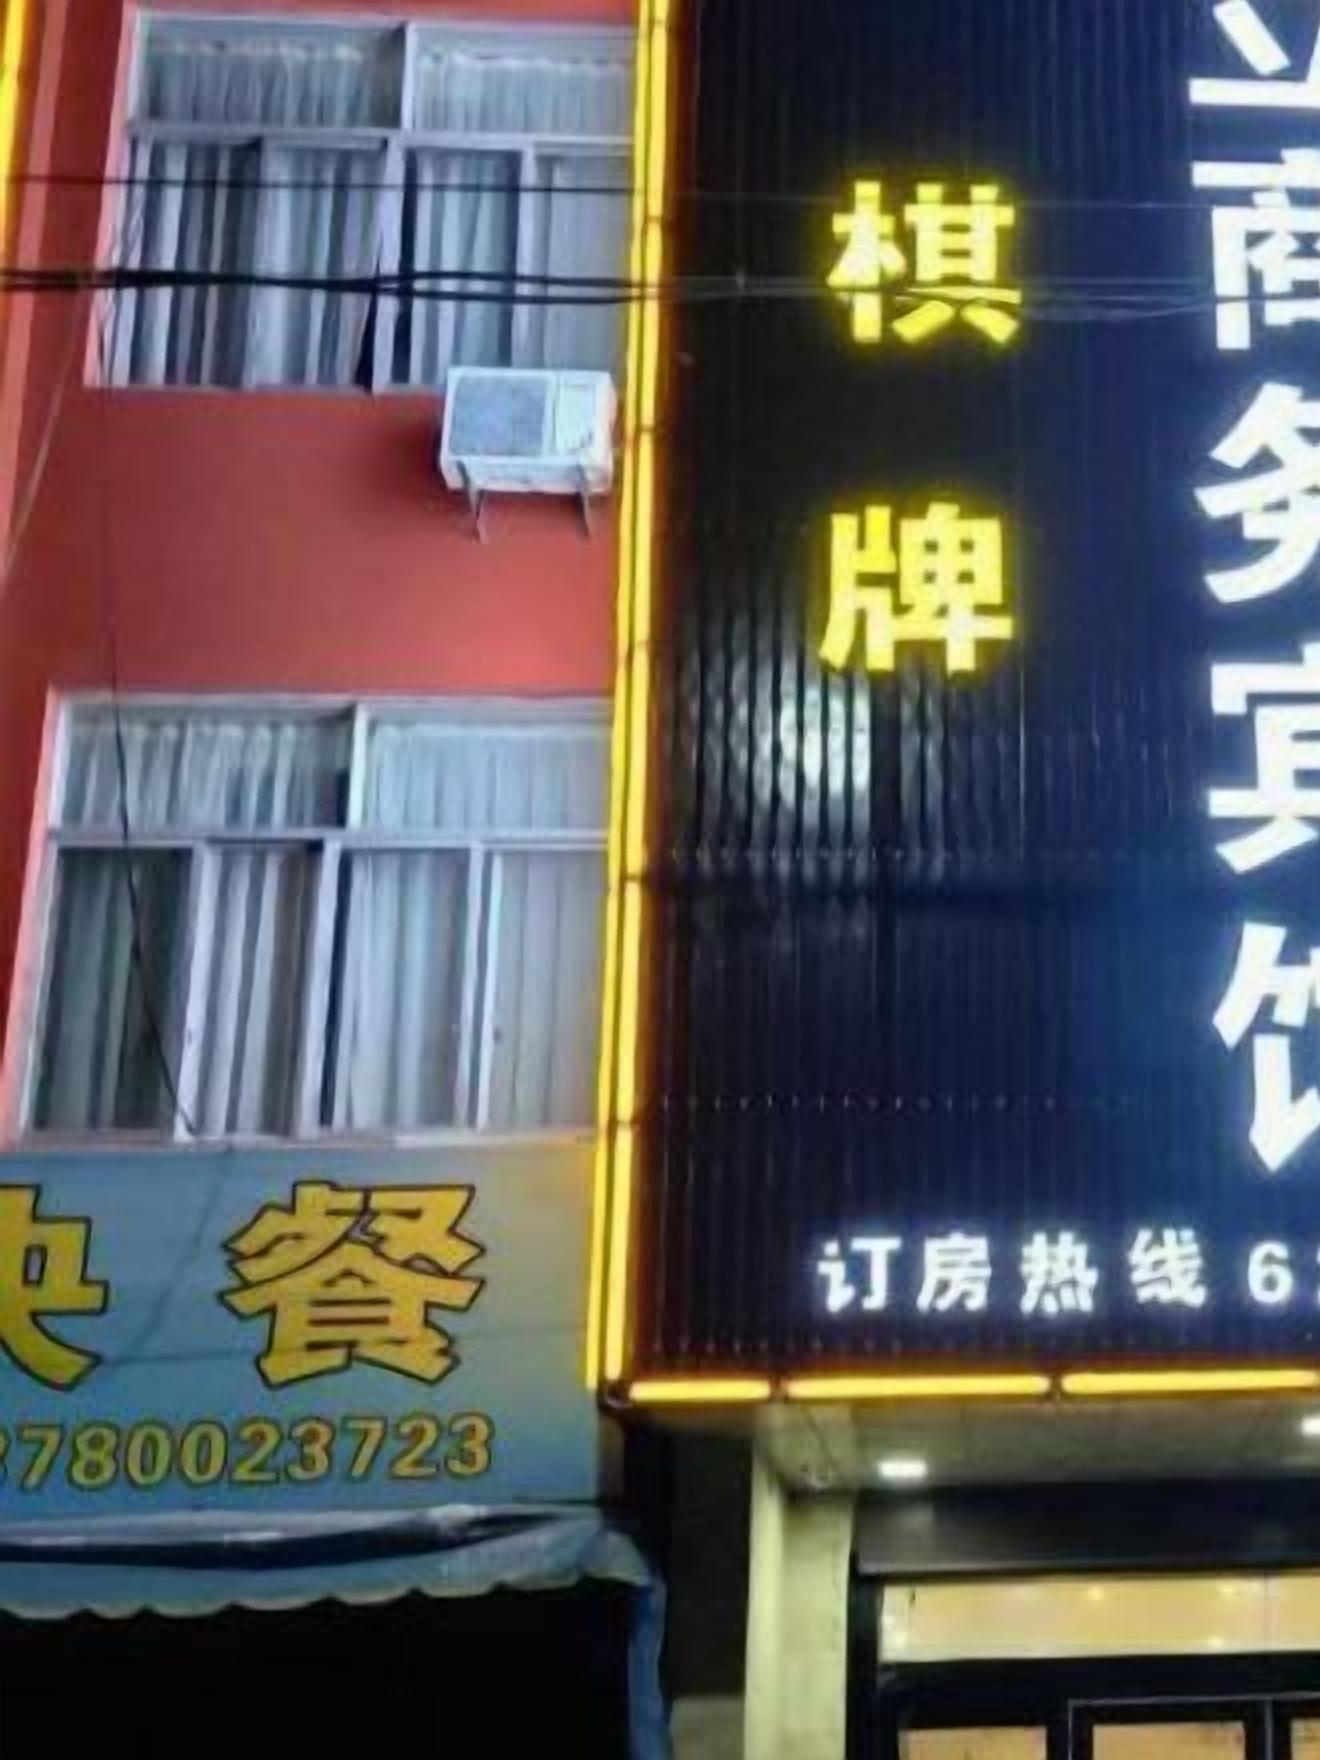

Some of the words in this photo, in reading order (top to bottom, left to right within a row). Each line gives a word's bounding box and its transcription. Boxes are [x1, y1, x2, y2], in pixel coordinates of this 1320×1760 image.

[819, 179, 1024, 677] 棋牌
[815, 1228, 1211, 1316] 订房热线
[0, 1413, 496, 1495] 780023723
